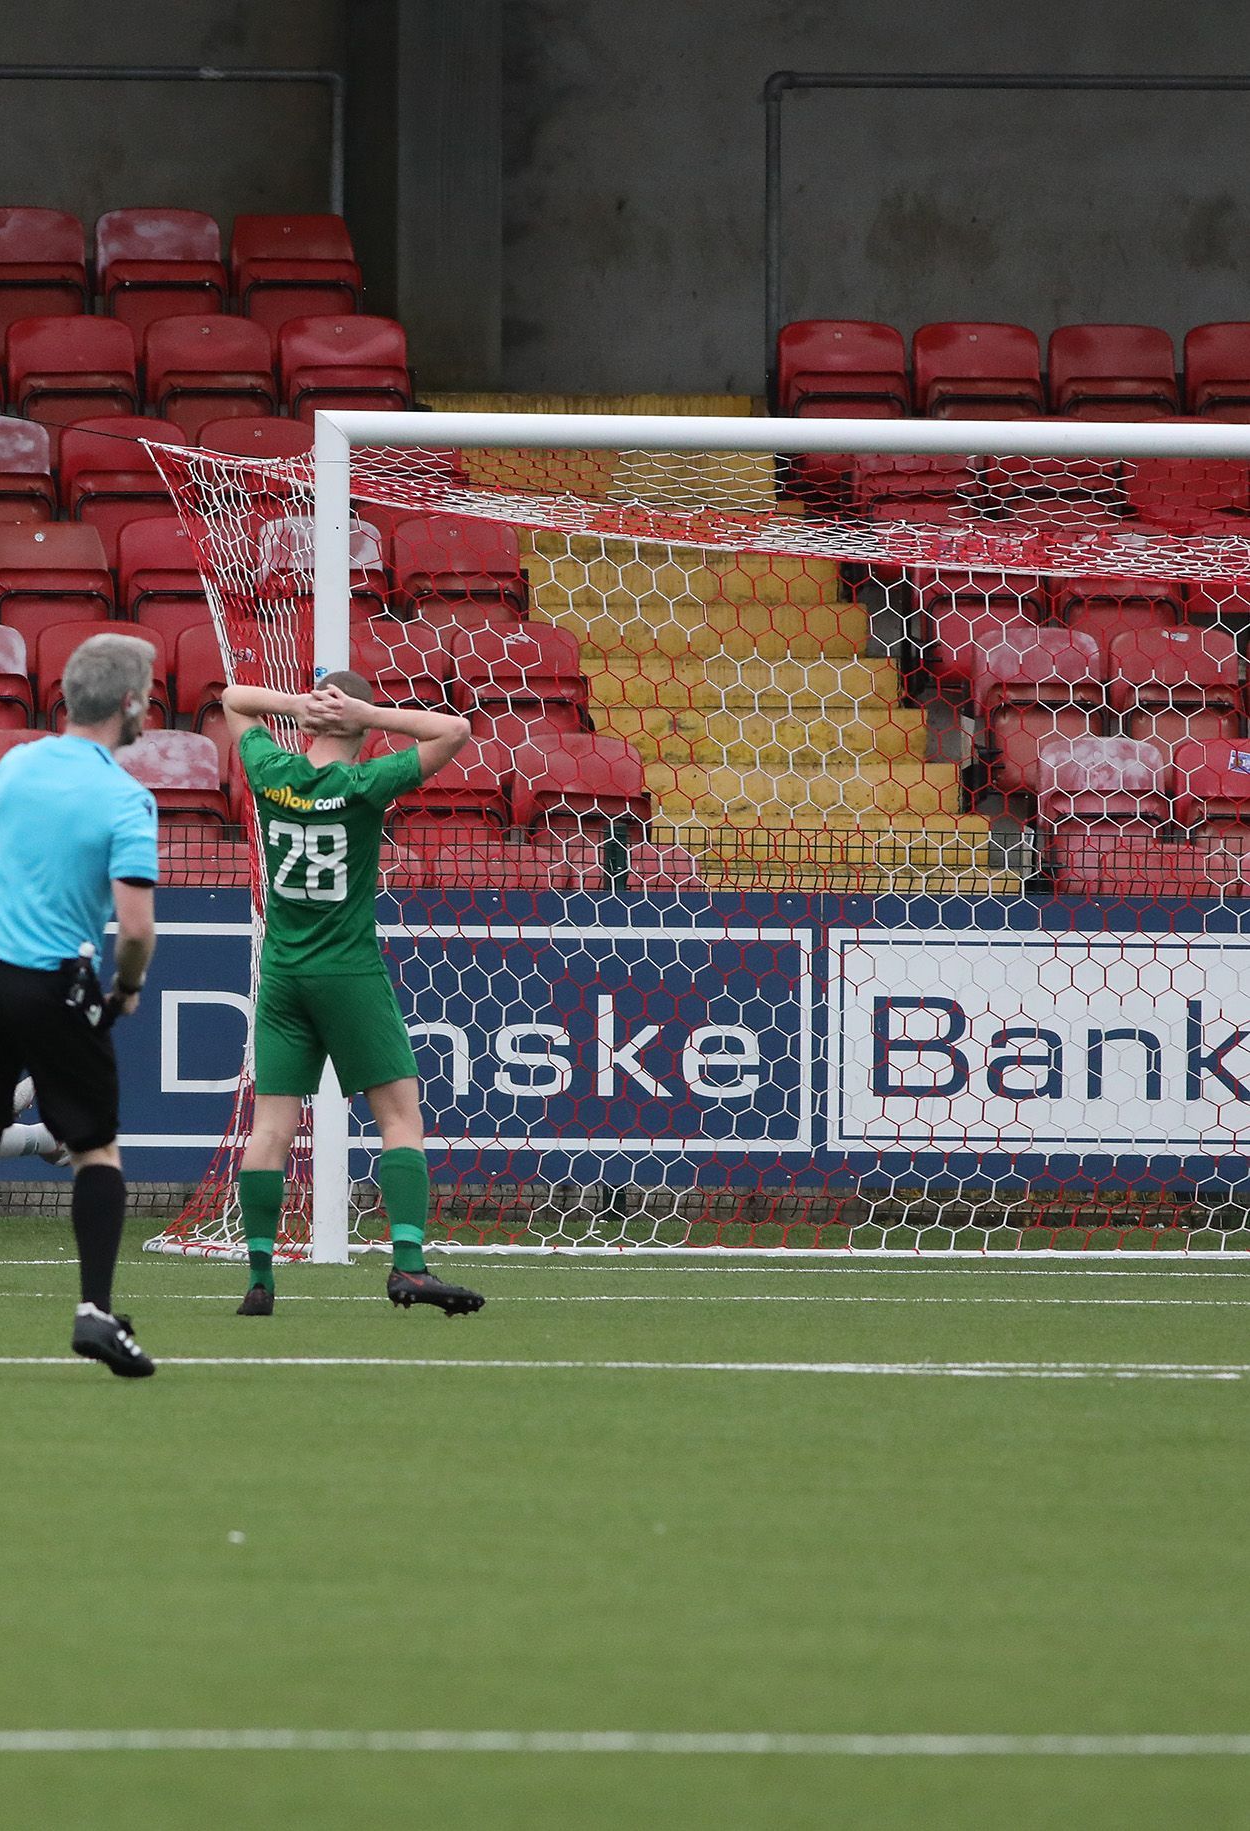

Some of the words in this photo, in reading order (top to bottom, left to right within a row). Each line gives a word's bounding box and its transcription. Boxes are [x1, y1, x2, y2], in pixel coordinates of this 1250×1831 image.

[268, 819, 348, 901] 28
[160, 989, 760, 1099] Dnske
[872, 995, 1250, 1102] Bank
